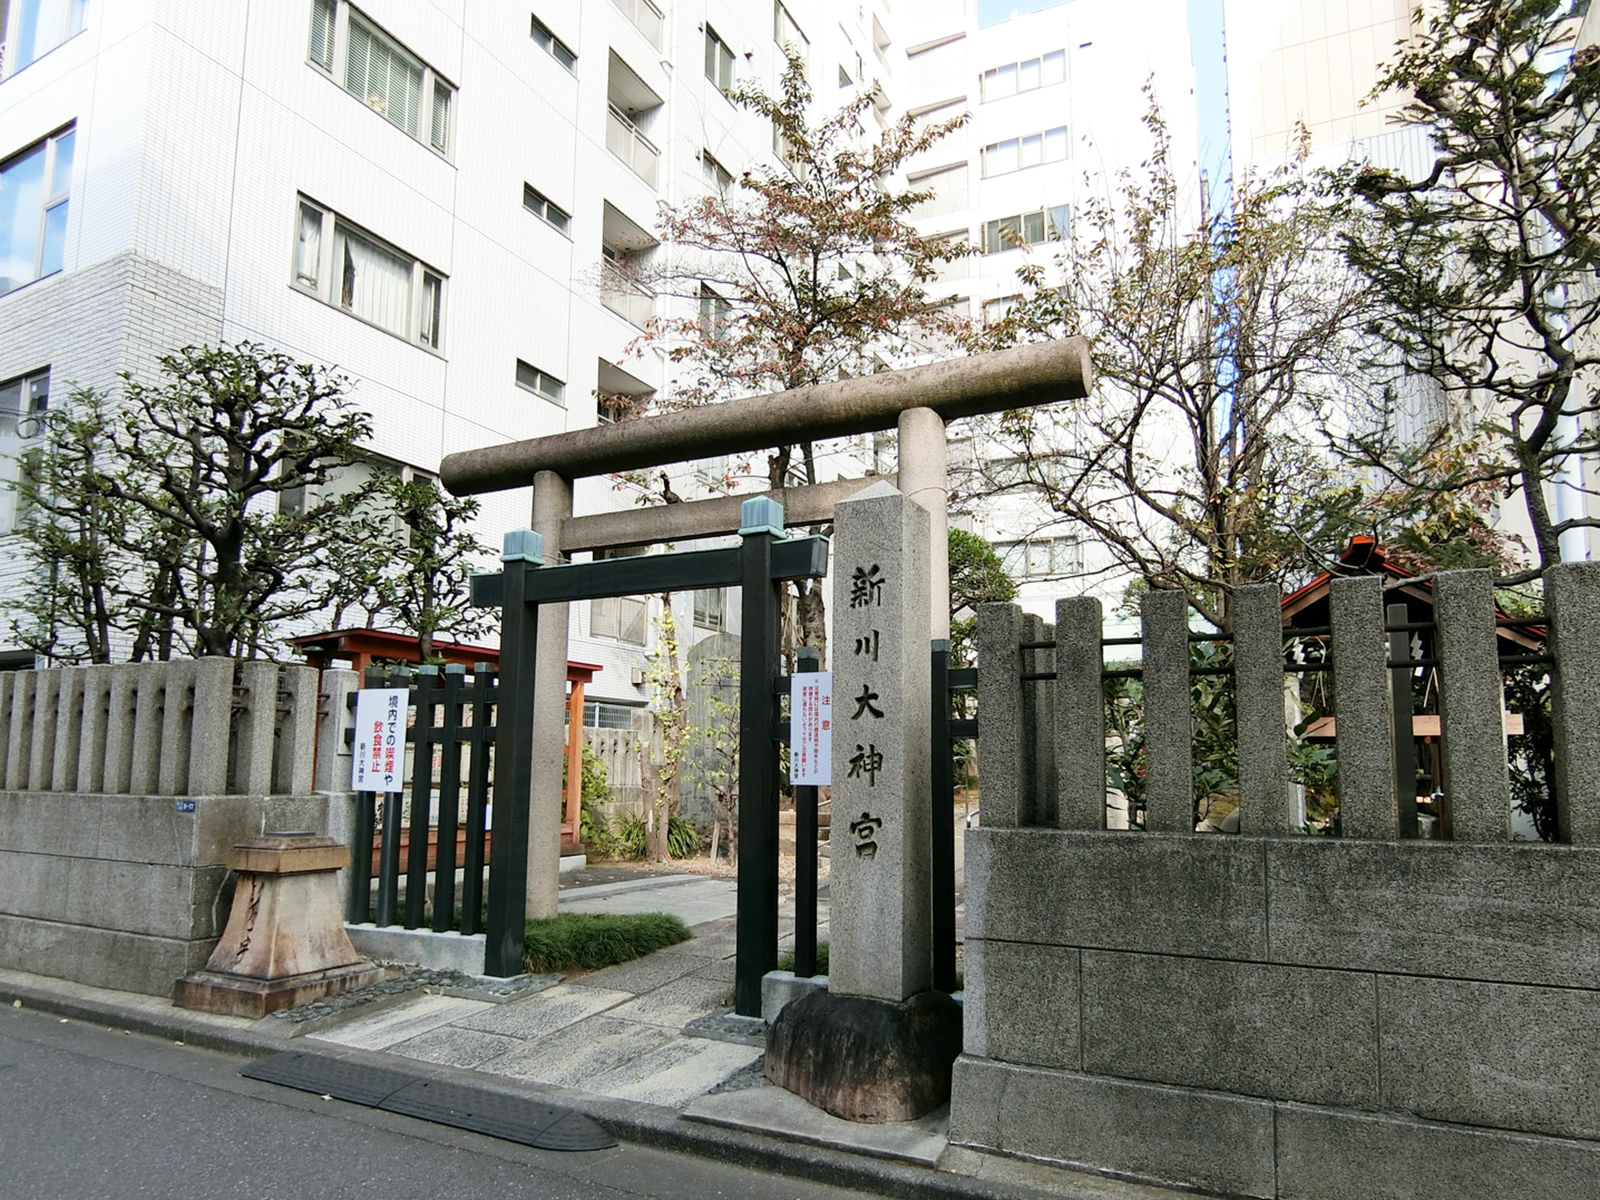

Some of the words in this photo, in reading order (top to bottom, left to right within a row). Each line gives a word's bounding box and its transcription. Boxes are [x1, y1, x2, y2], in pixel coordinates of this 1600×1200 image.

[822, 695, 831, 730] 注意
[848, 564, 885, 860] 新川大神宮
[358, 742, 366, 783] 新川大神宮
[372, 721, 383, 772] 飲食禁止
[384, 695, 399, 786] 境内での喫煙や
